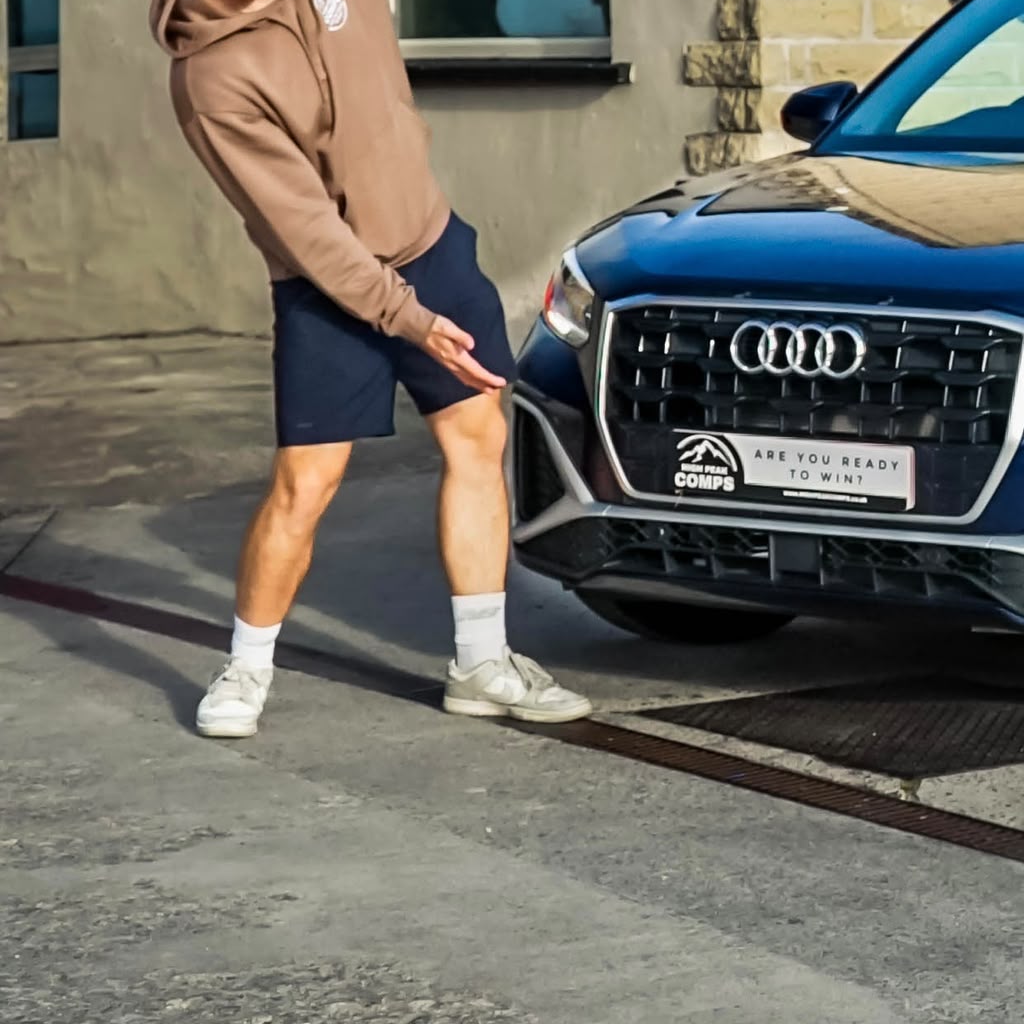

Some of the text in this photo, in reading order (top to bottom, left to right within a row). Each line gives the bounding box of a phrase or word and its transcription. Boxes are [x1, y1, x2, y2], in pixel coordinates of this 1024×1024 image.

[755, 449, 899, 471] ARE YOU READY
[674, 472, 735, 492] COMPS
[790, 469, 863, 485] TO WIN?
